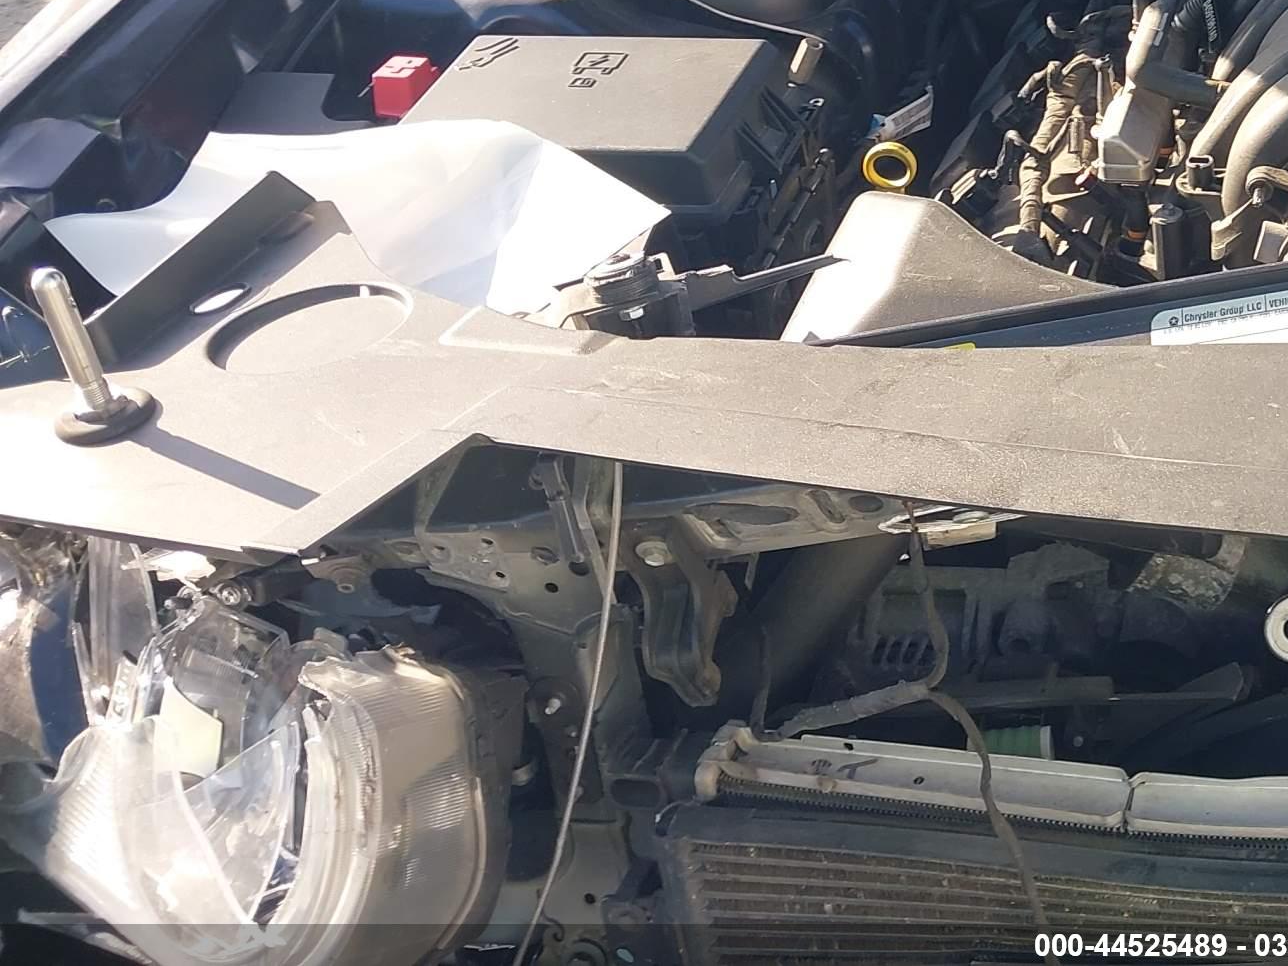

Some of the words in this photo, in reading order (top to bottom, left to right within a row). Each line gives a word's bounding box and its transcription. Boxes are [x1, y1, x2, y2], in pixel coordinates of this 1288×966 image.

[1184, 309, 1217, 324] Chrysler
[1219, 305, 1244, 318] Group
[1246, 302, 1262, 312] LLC
